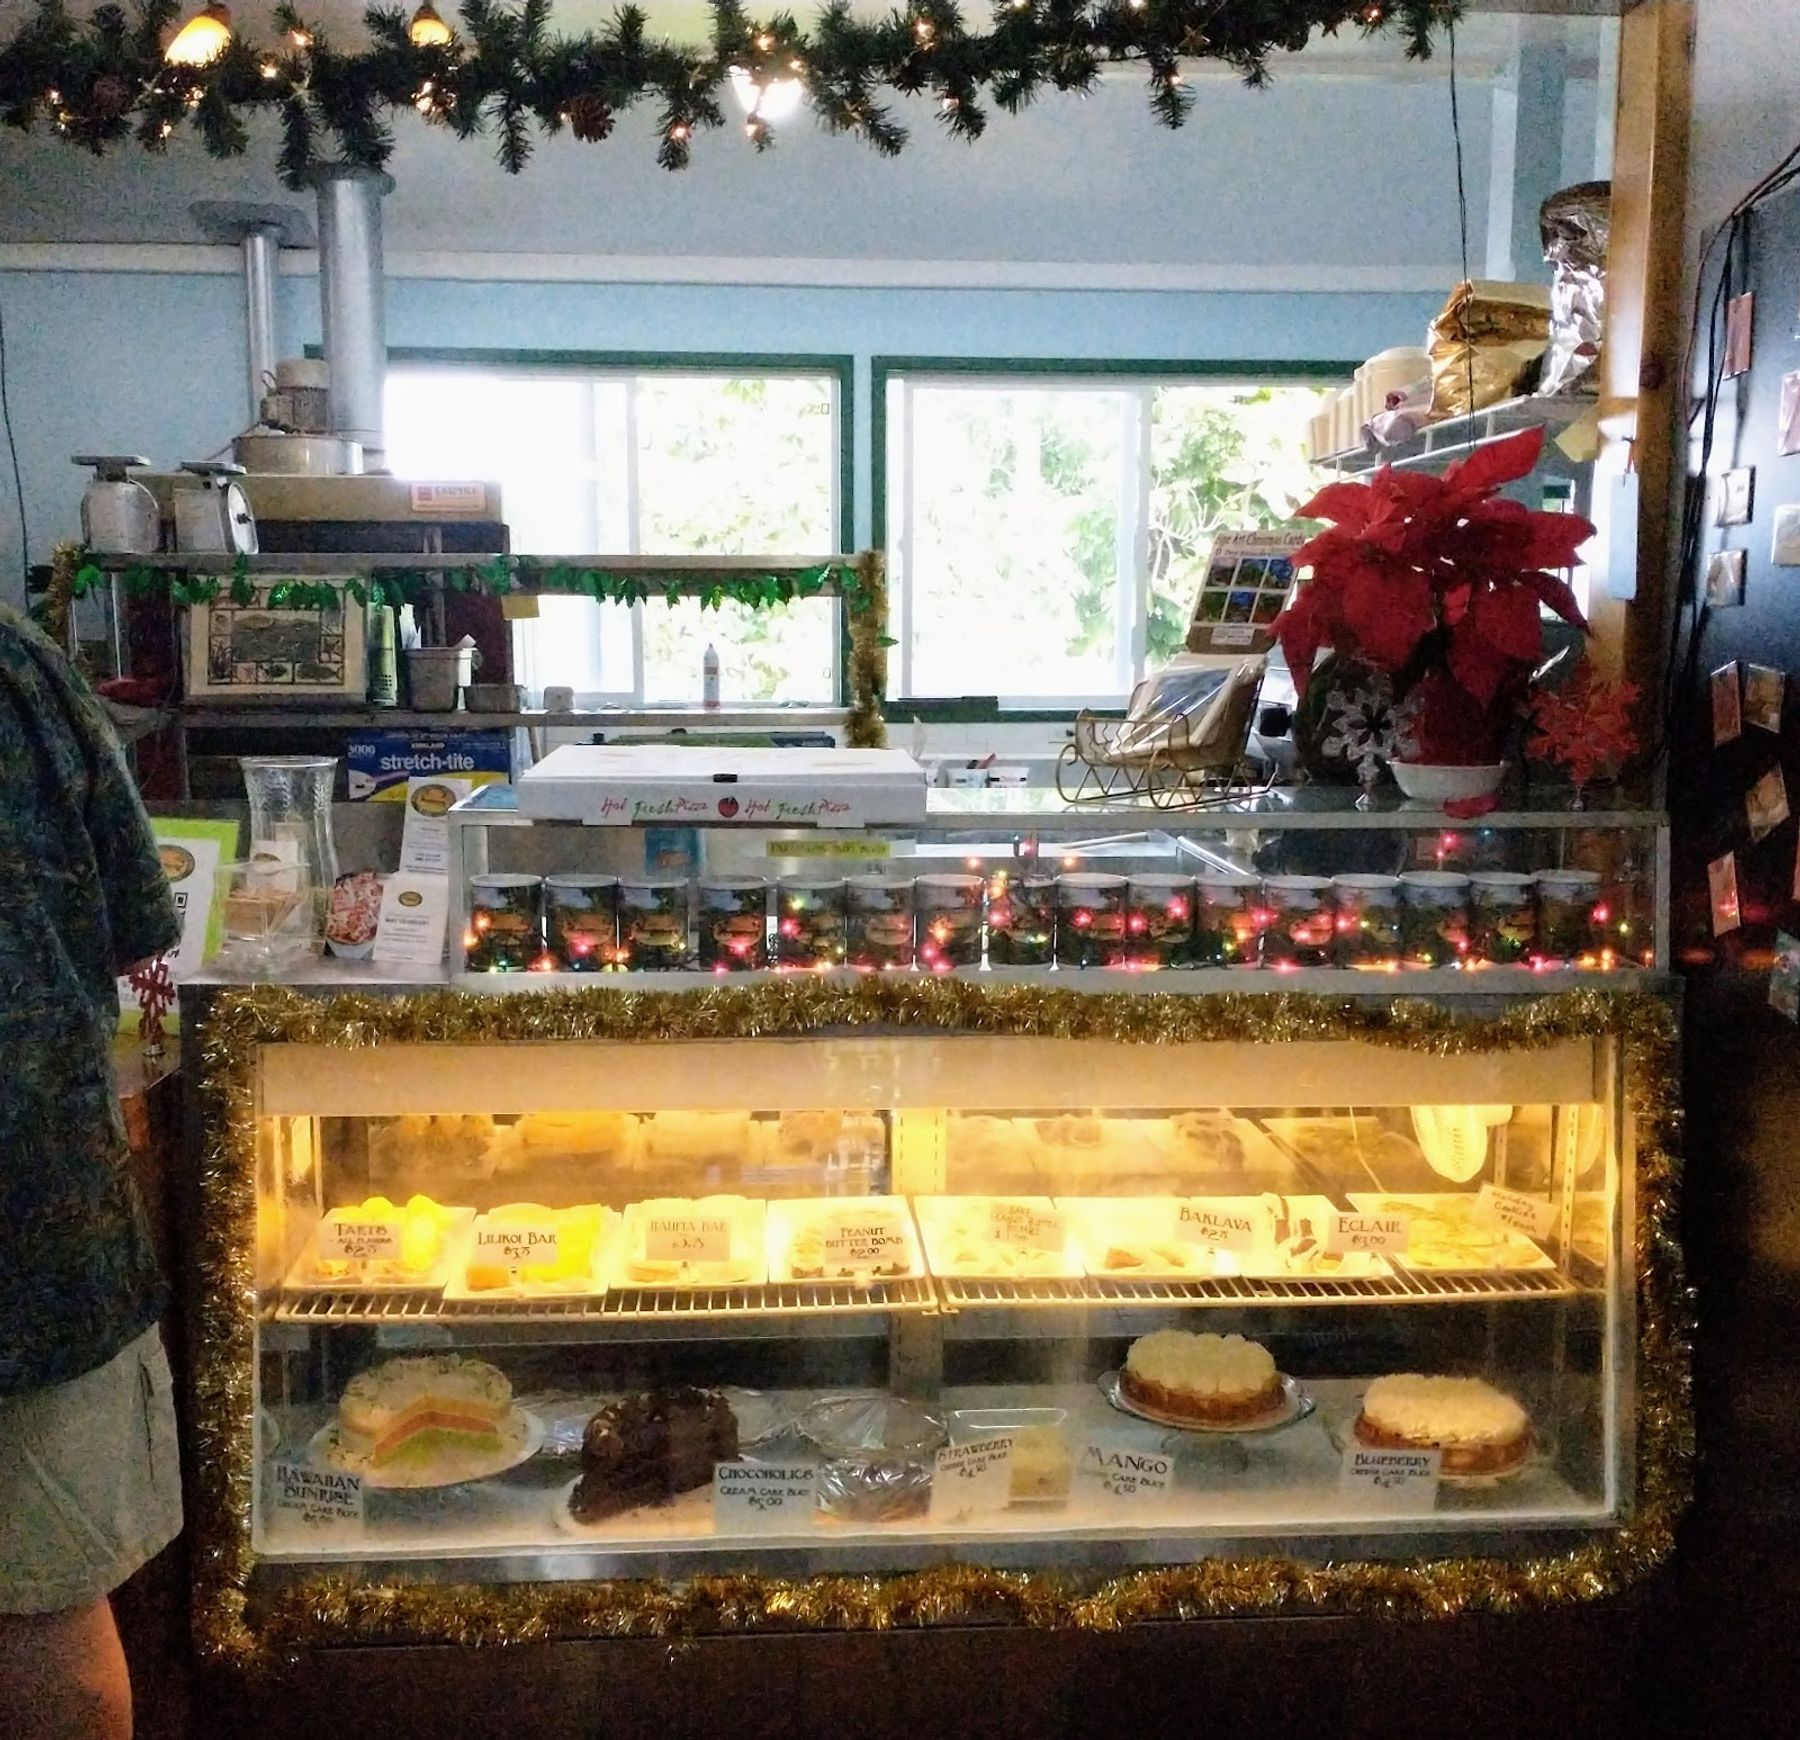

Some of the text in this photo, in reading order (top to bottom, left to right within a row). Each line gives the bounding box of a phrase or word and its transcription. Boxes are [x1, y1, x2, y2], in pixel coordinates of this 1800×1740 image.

[380, 752, 475, 771] stretch-tite
[601, 797, 628, 819] Hot
[675, 797, 709, 814] Pizza
[744, 798, 772, 819] Hot
[1180, 1206, 1252, 1232] BAKLAVA
[1338, 1216, 1402, 1234] ECLAIR
[334, 1223, 388, 1236] TARTS
[478, 1231, 557, 1245] LILIKOI BAR
[841, 1227, 886, 1239] PEANUT
[825, 1238, 869, 1248] BUTTER
[938, 1438, 1013, 1461] STRAWBERRY
[1082, 1446, 1168, 1475] MANGO
[1354, 1452, 1431, 1467] BLUEBERRY
[277, 1464, 360, 1491] HAWAIIAN
[719, 1466, 814, 1481] CHOCOHOLICS
[283, 1482, 354, 1506] SUNRISE
[760, 1487, 785, 1497] CAKE
